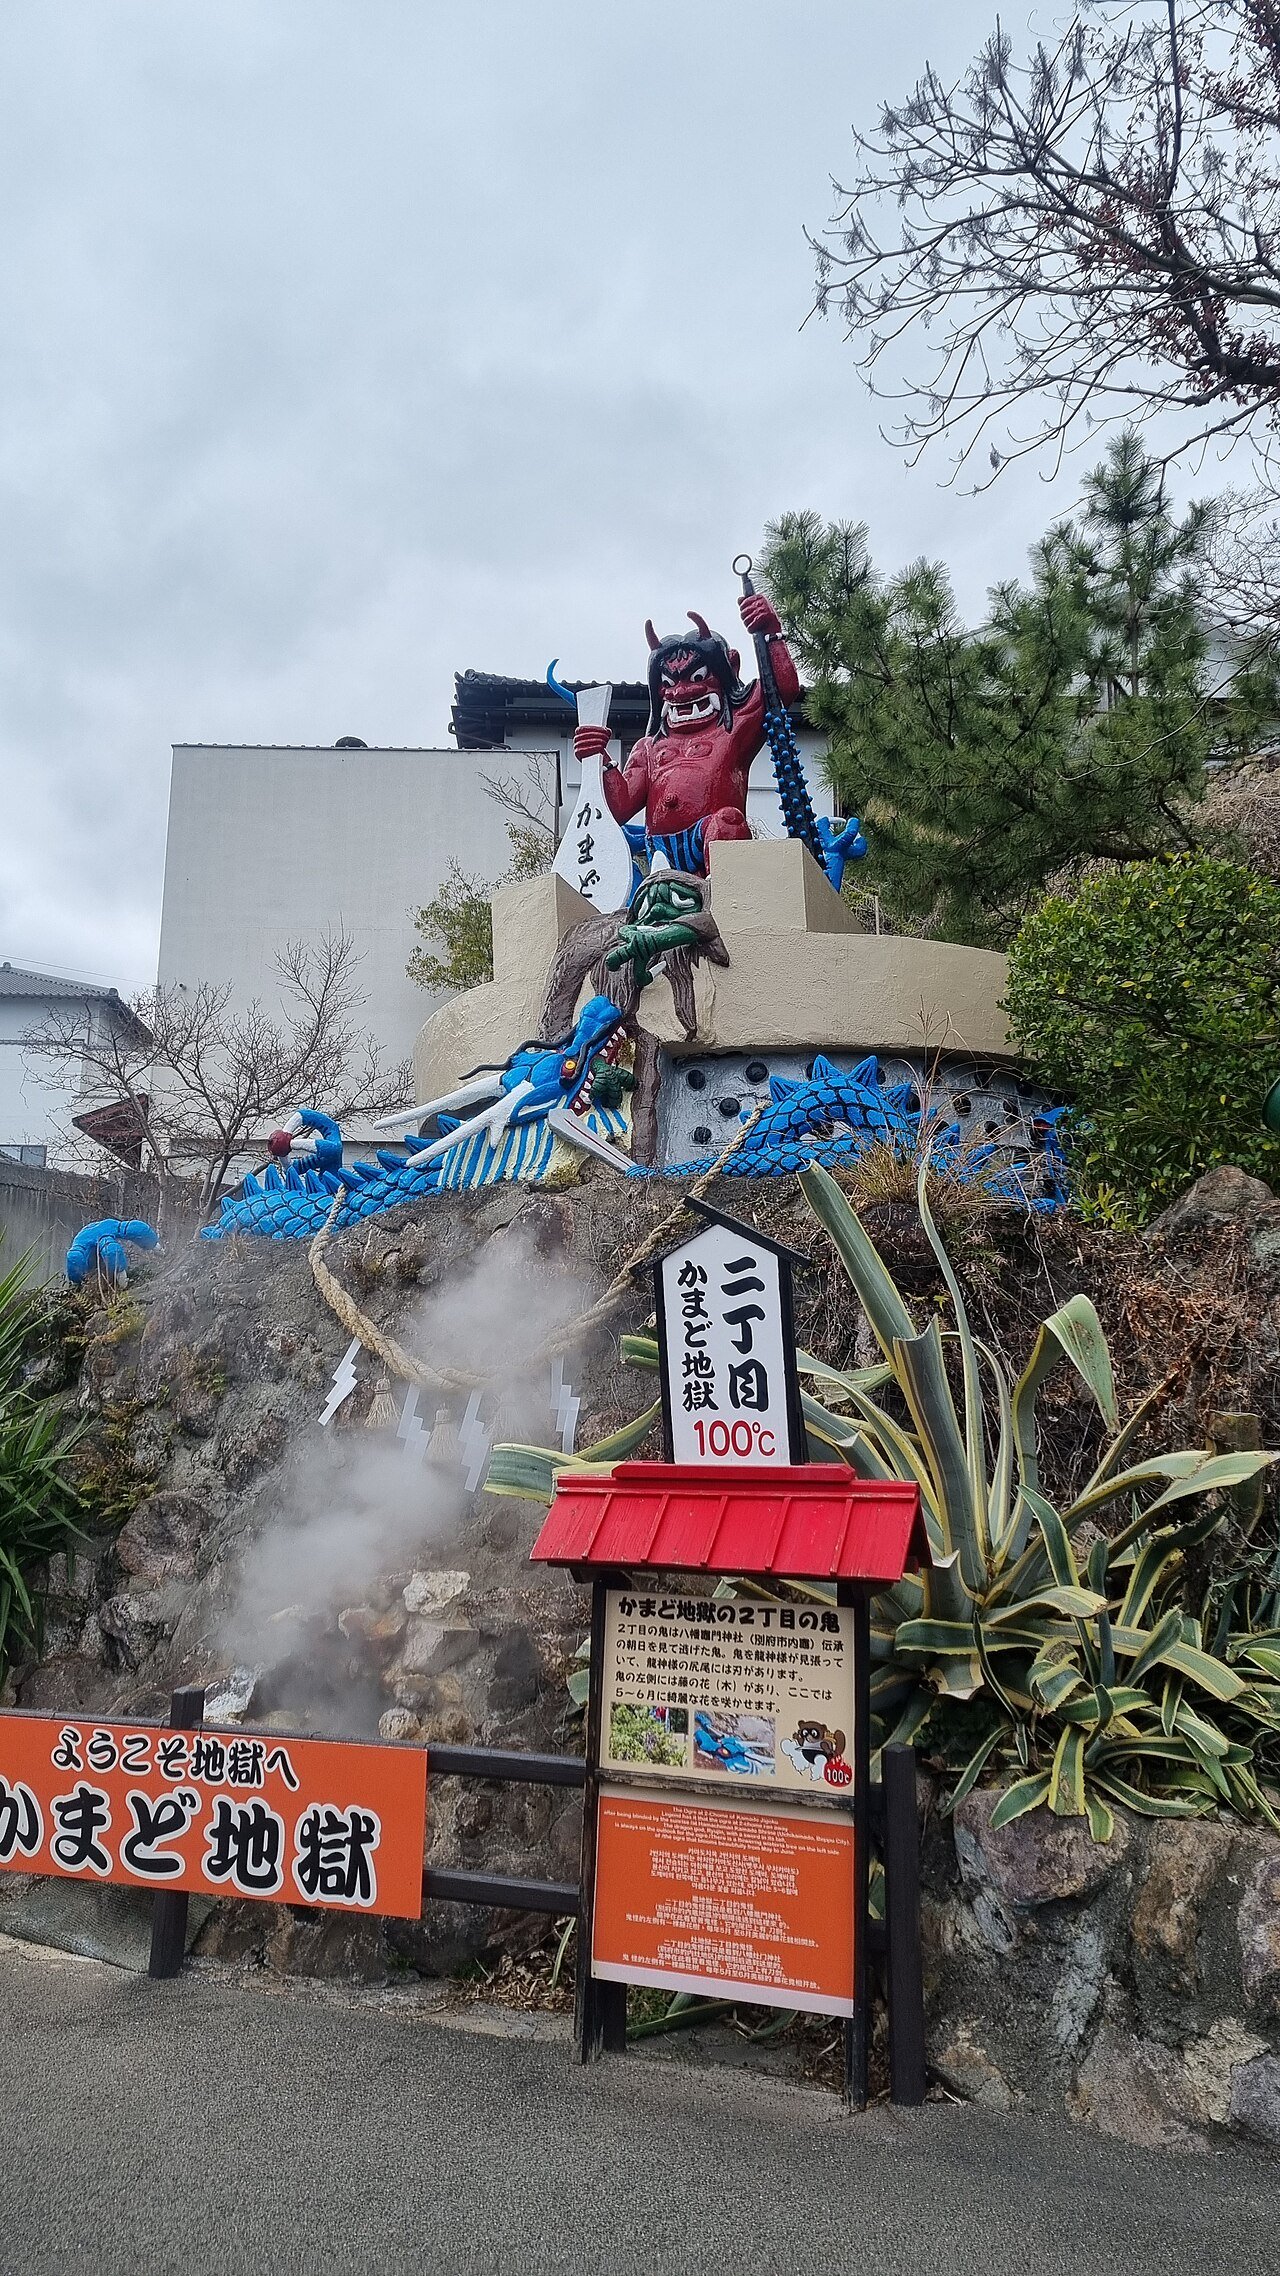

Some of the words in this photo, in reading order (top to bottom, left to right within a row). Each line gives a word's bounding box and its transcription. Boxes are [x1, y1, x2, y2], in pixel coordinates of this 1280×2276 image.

[576, 802, 602, 898] かまど
[676, 1260, 720, 1413] かまど地獄
[720, 1255, 770, 1413] 二丁目
[51, 1726, 300, 1791] ようこそ地獄へ
